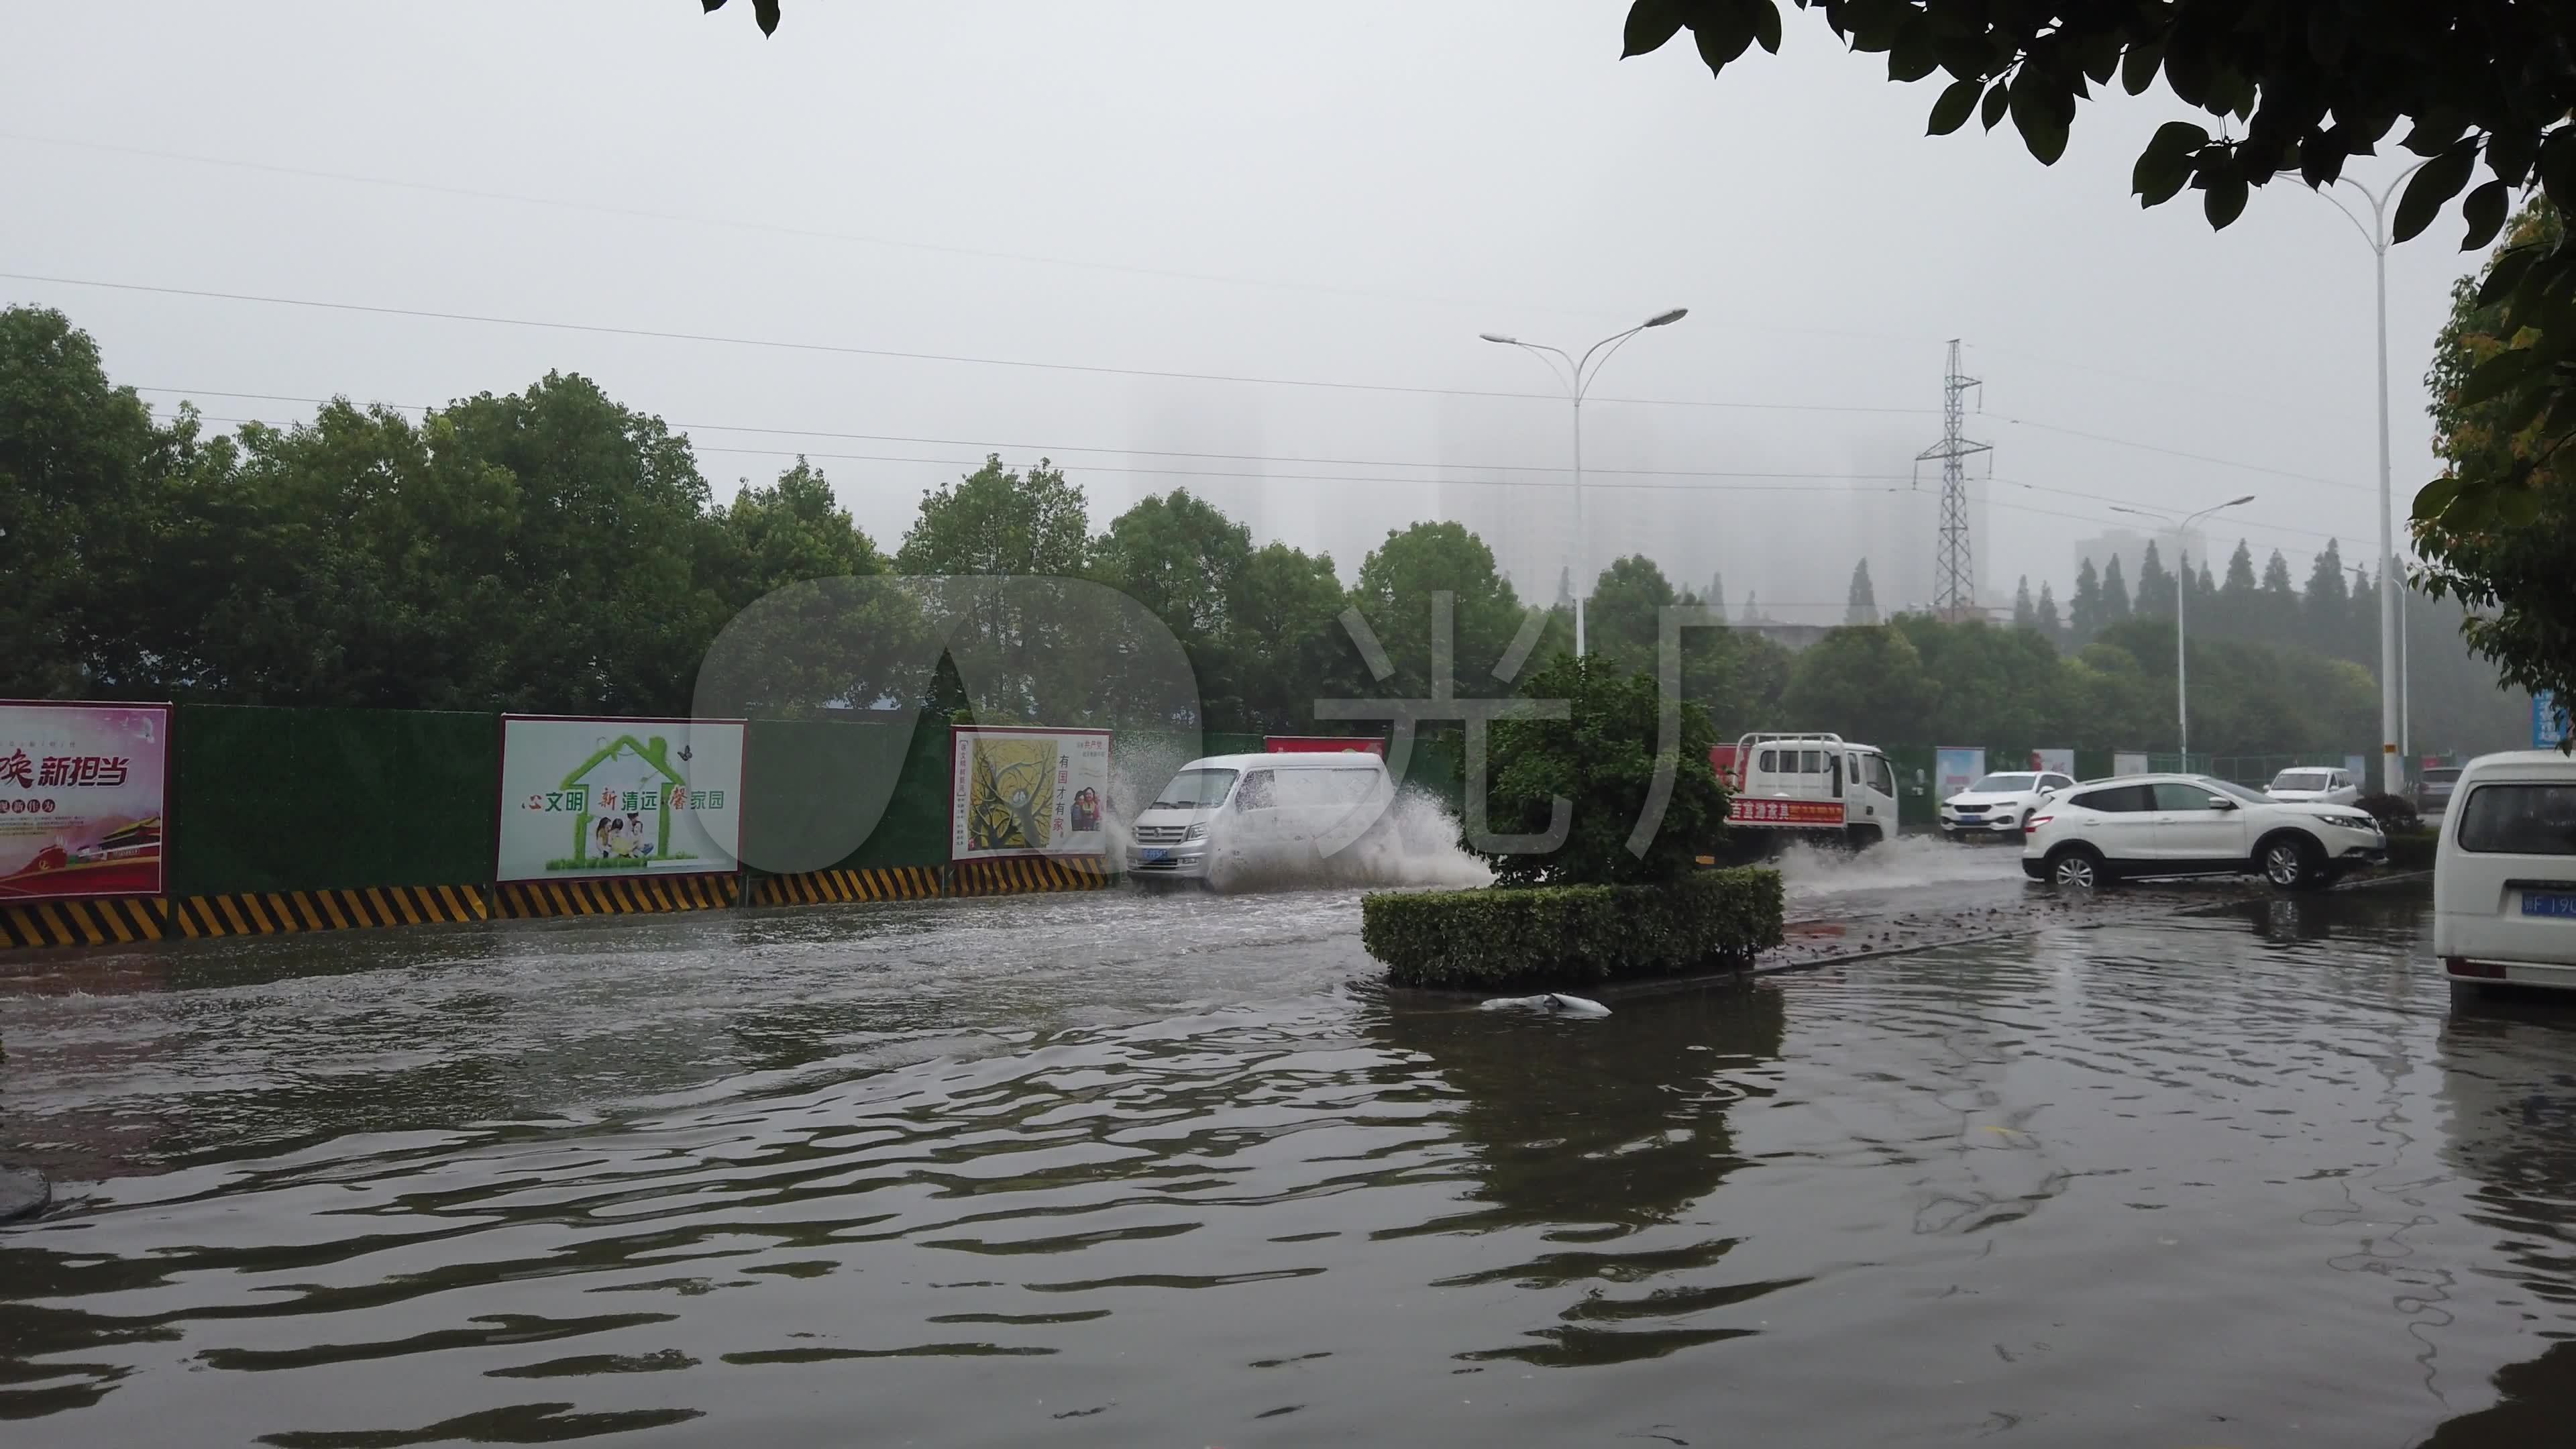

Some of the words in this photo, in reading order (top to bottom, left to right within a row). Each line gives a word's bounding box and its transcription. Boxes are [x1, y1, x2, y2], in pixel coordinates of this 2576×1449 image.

[1053, 754, 1069, 831] 有国才有家
